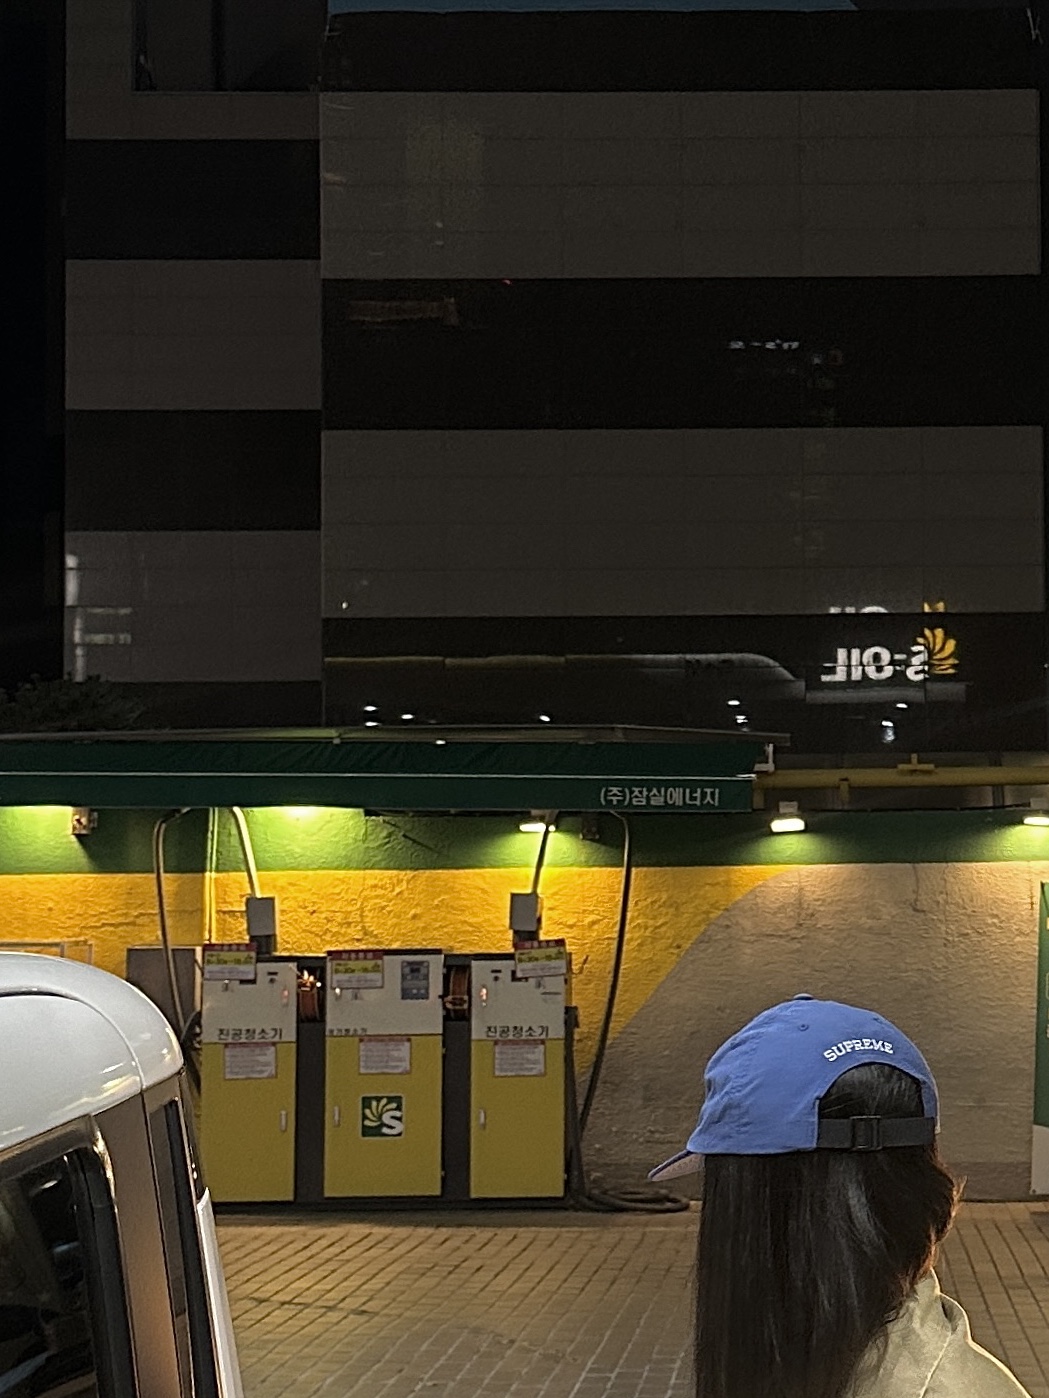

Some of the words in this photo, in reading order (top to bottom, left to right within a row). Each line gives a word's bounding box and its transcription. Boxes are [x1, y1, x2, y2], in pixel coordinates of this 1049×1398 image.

[600, 786, 720, 807] (주)잠실에너지
[217, 1027, 283, 1041] 진공청소기
[485, 1025, 549, 1038] 진공청소기
[823, 1038, 894, 1063] SUPREME
